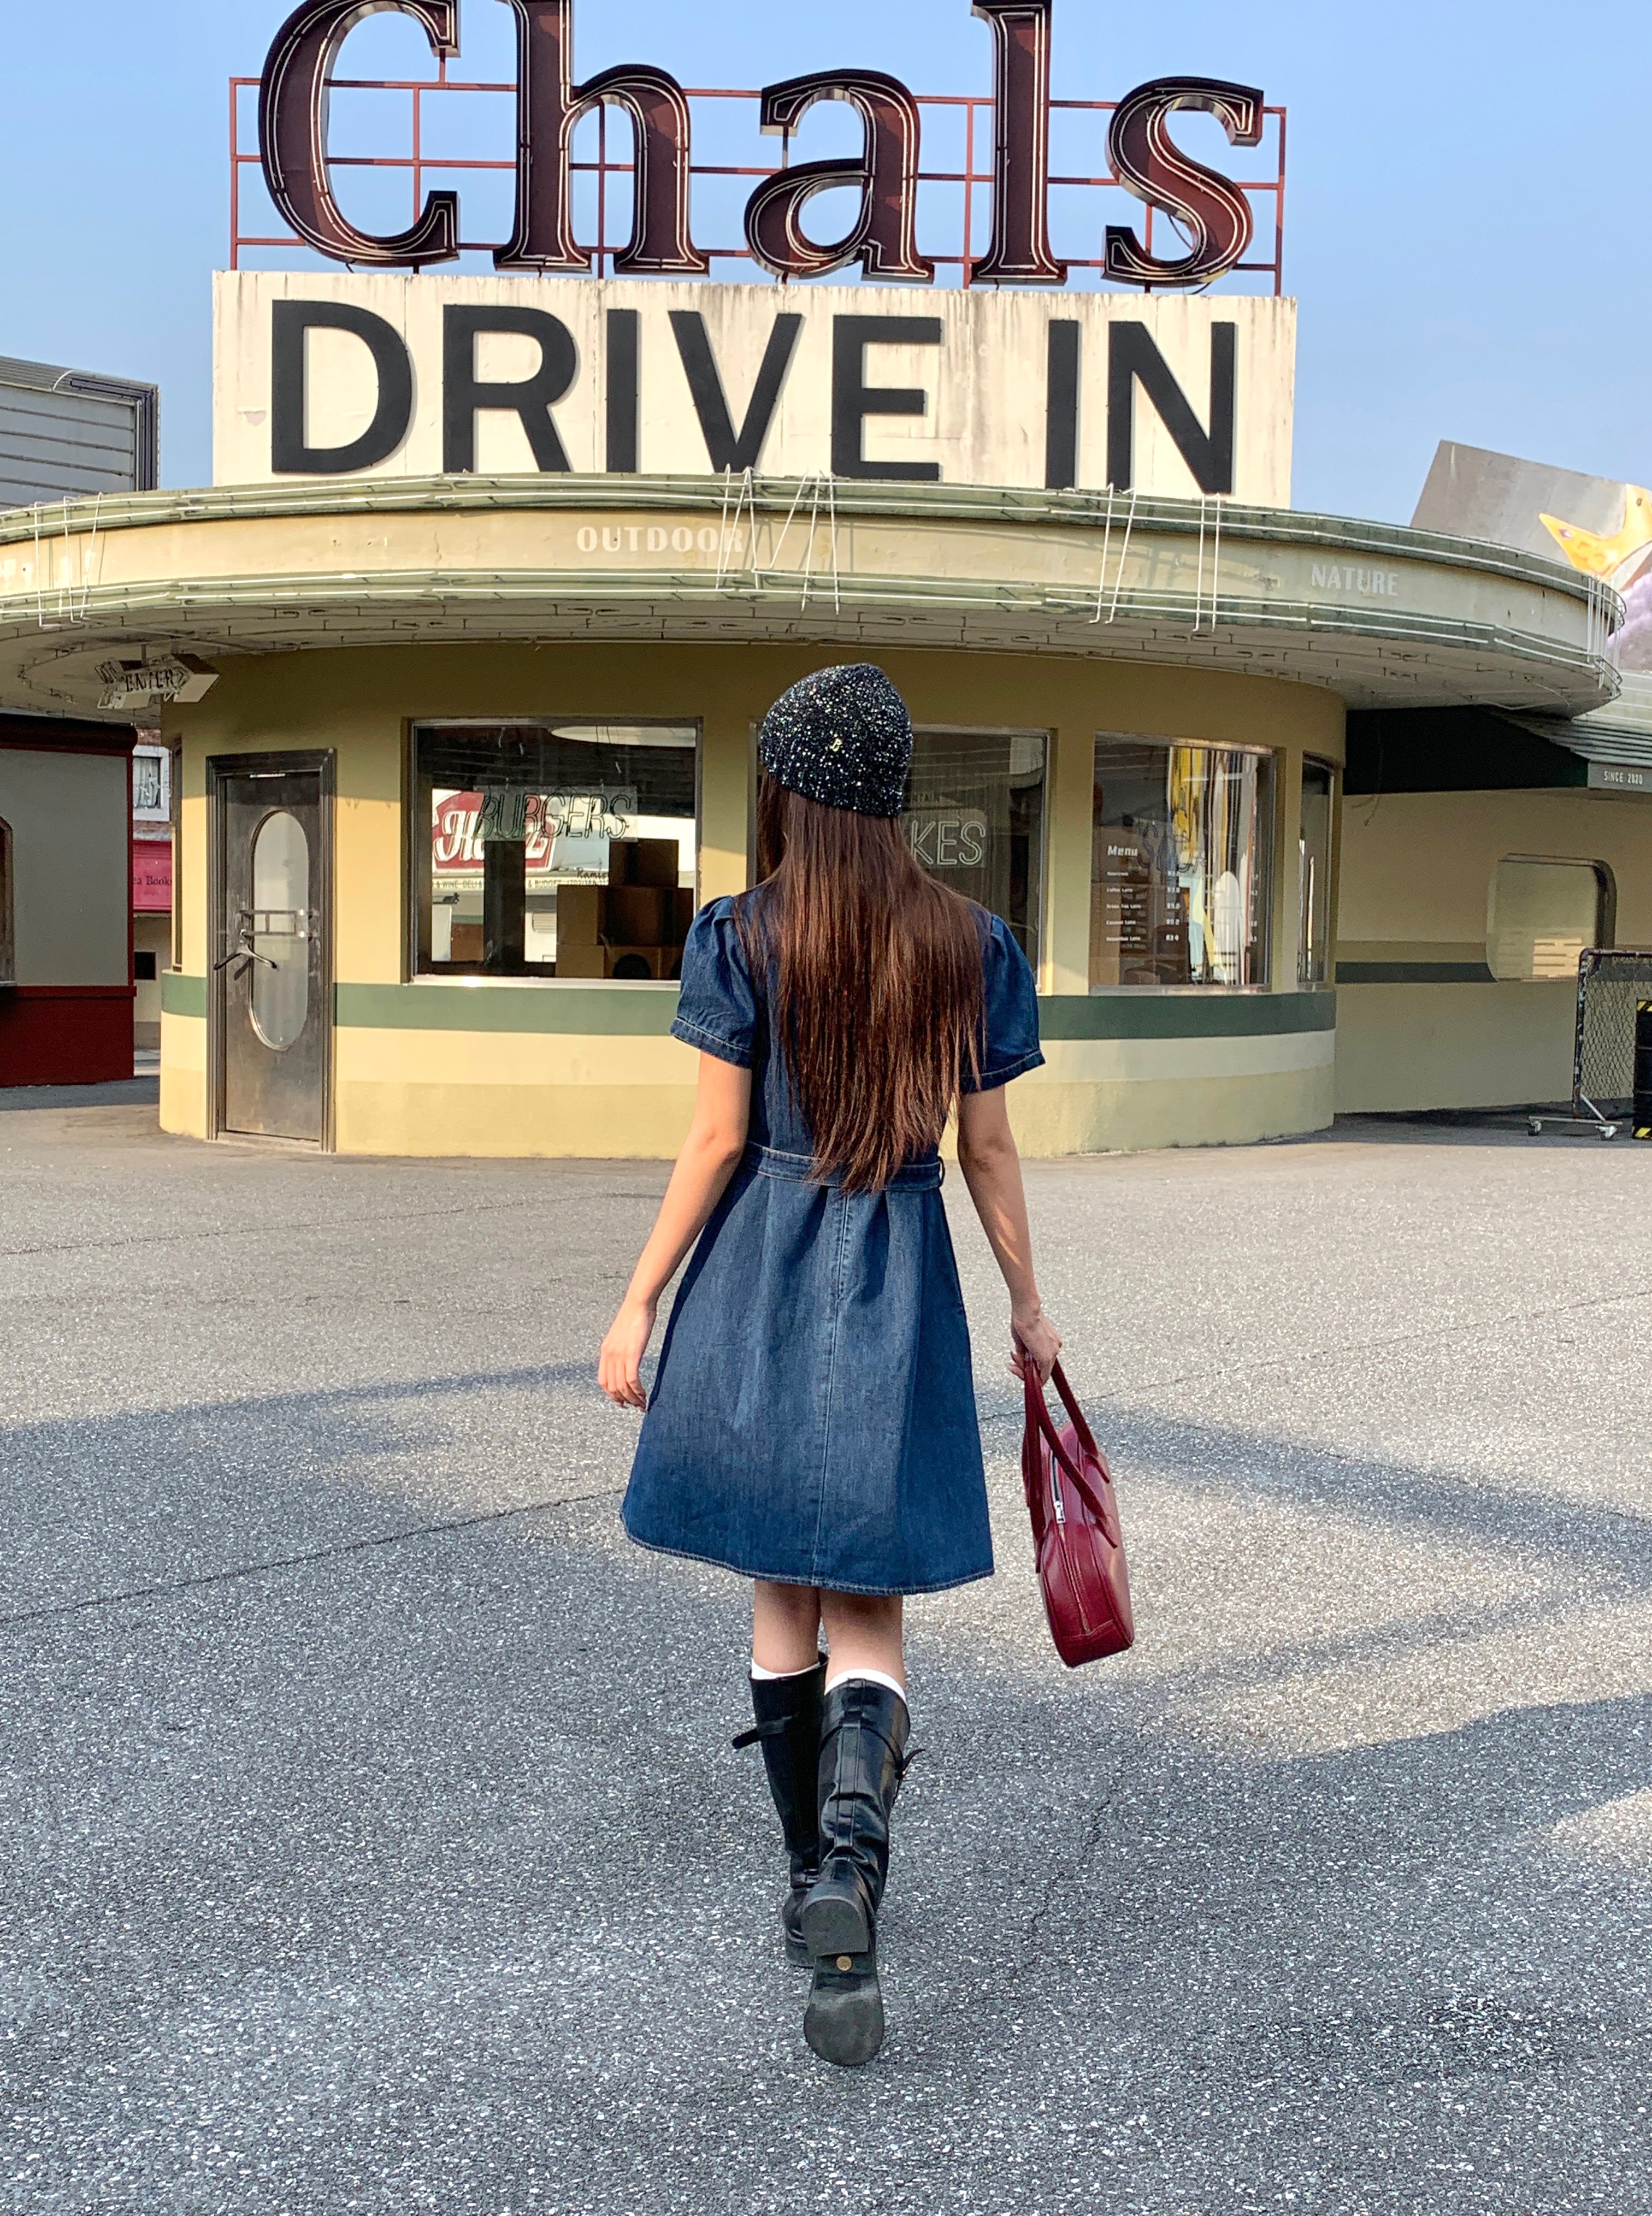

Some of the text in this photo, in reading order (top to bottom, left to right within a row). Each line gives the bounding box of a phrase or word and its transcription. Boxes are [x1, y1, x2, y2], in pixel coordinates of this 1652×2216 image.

[258, 0, 1264, 286] Chals
[272, 299, 1236, 493] DRIVE IN
[576, 526, 744, 552] OUTDOOR
[1312, 563, 1399, 596] NATURE
[1603, 770, 1624, 783] SINCE
[474, 794, 630, 840] BURGERS
[1107, 845, 1138, 857] Menu
